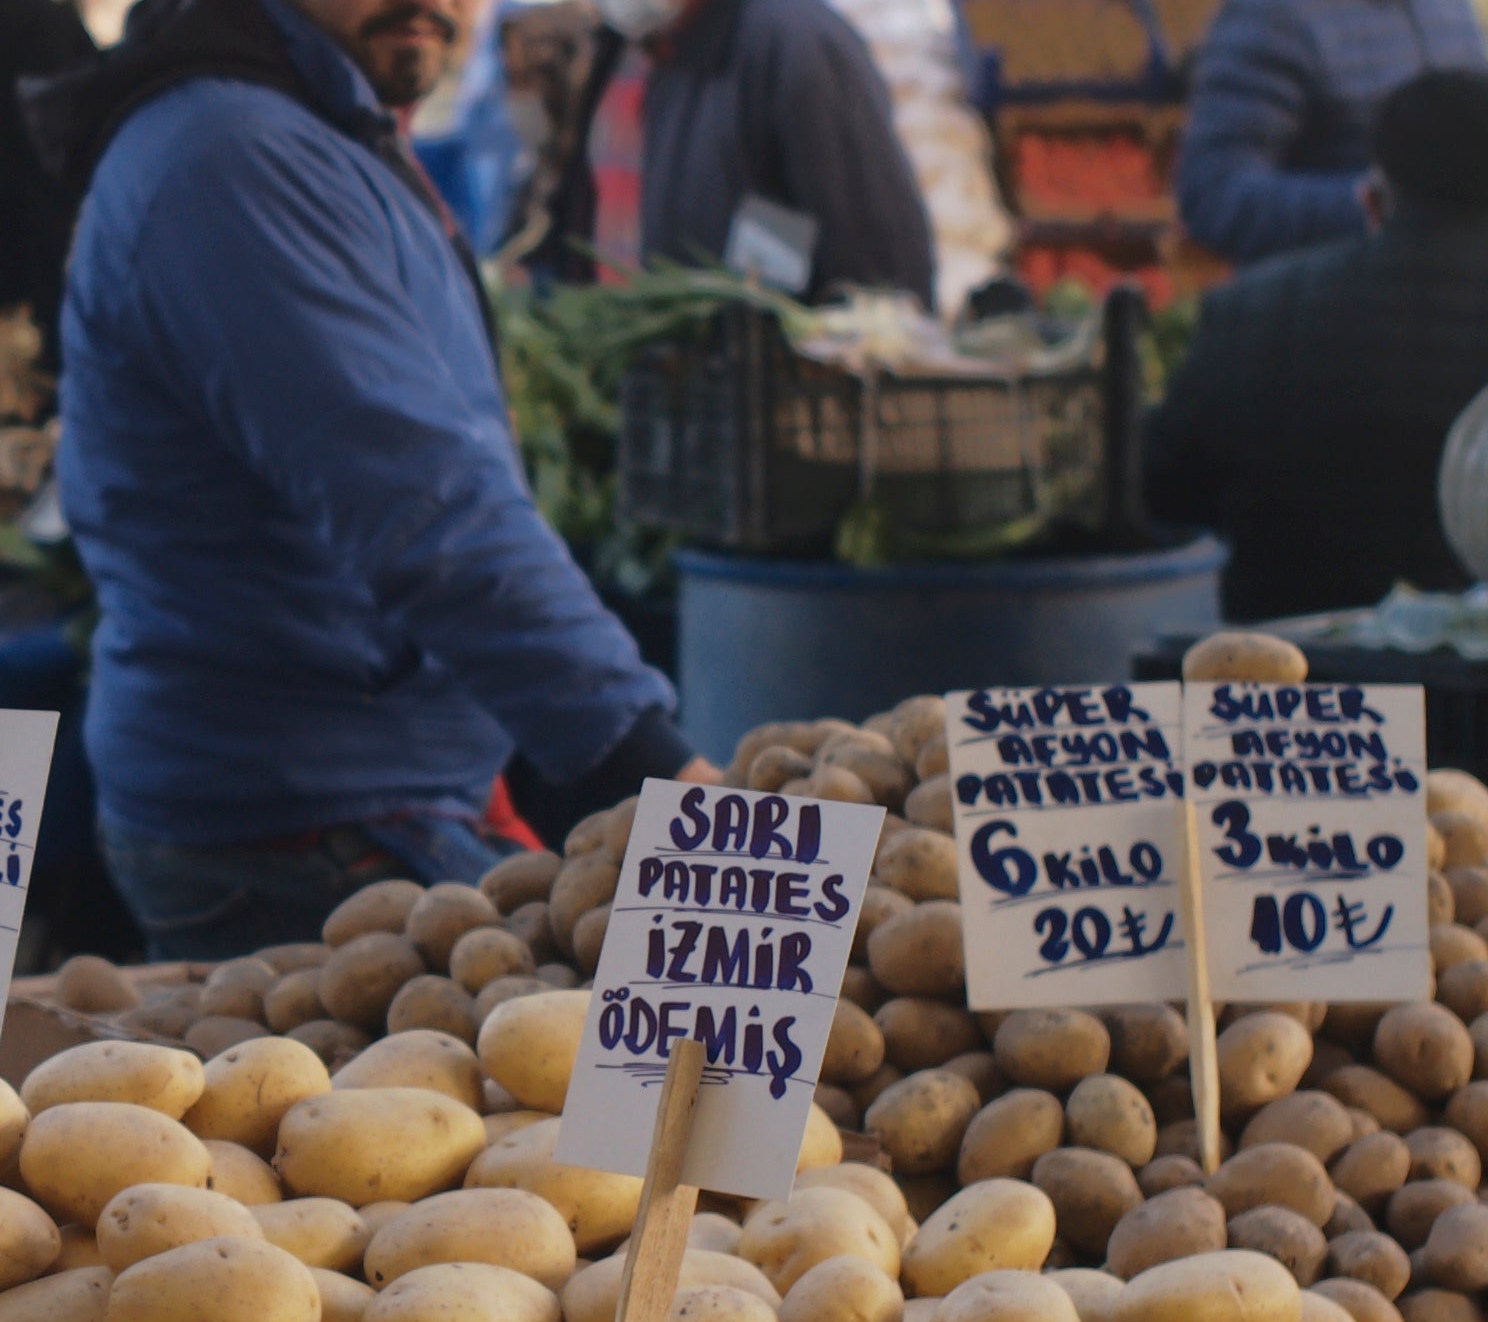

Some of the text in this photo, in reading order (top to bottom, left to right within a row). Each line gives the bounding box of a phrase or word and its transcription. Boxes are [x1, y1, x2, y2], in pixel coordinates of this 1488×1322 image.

[962, 686, 1151, 732] SÜPER
[1208, 682, 1385, 725] SÜPER
[997, 728, 1170, 765] AFYON
[1230, 730, 1388, 761] AFYON
[669, 786, 823, 864] SARI
[1211, 799, 1262, 870] 3
[638, 857, 850, 922] PATATES
[969, 819, 1038, 897] 6
[646, 914, 814, 994] İZMİR
